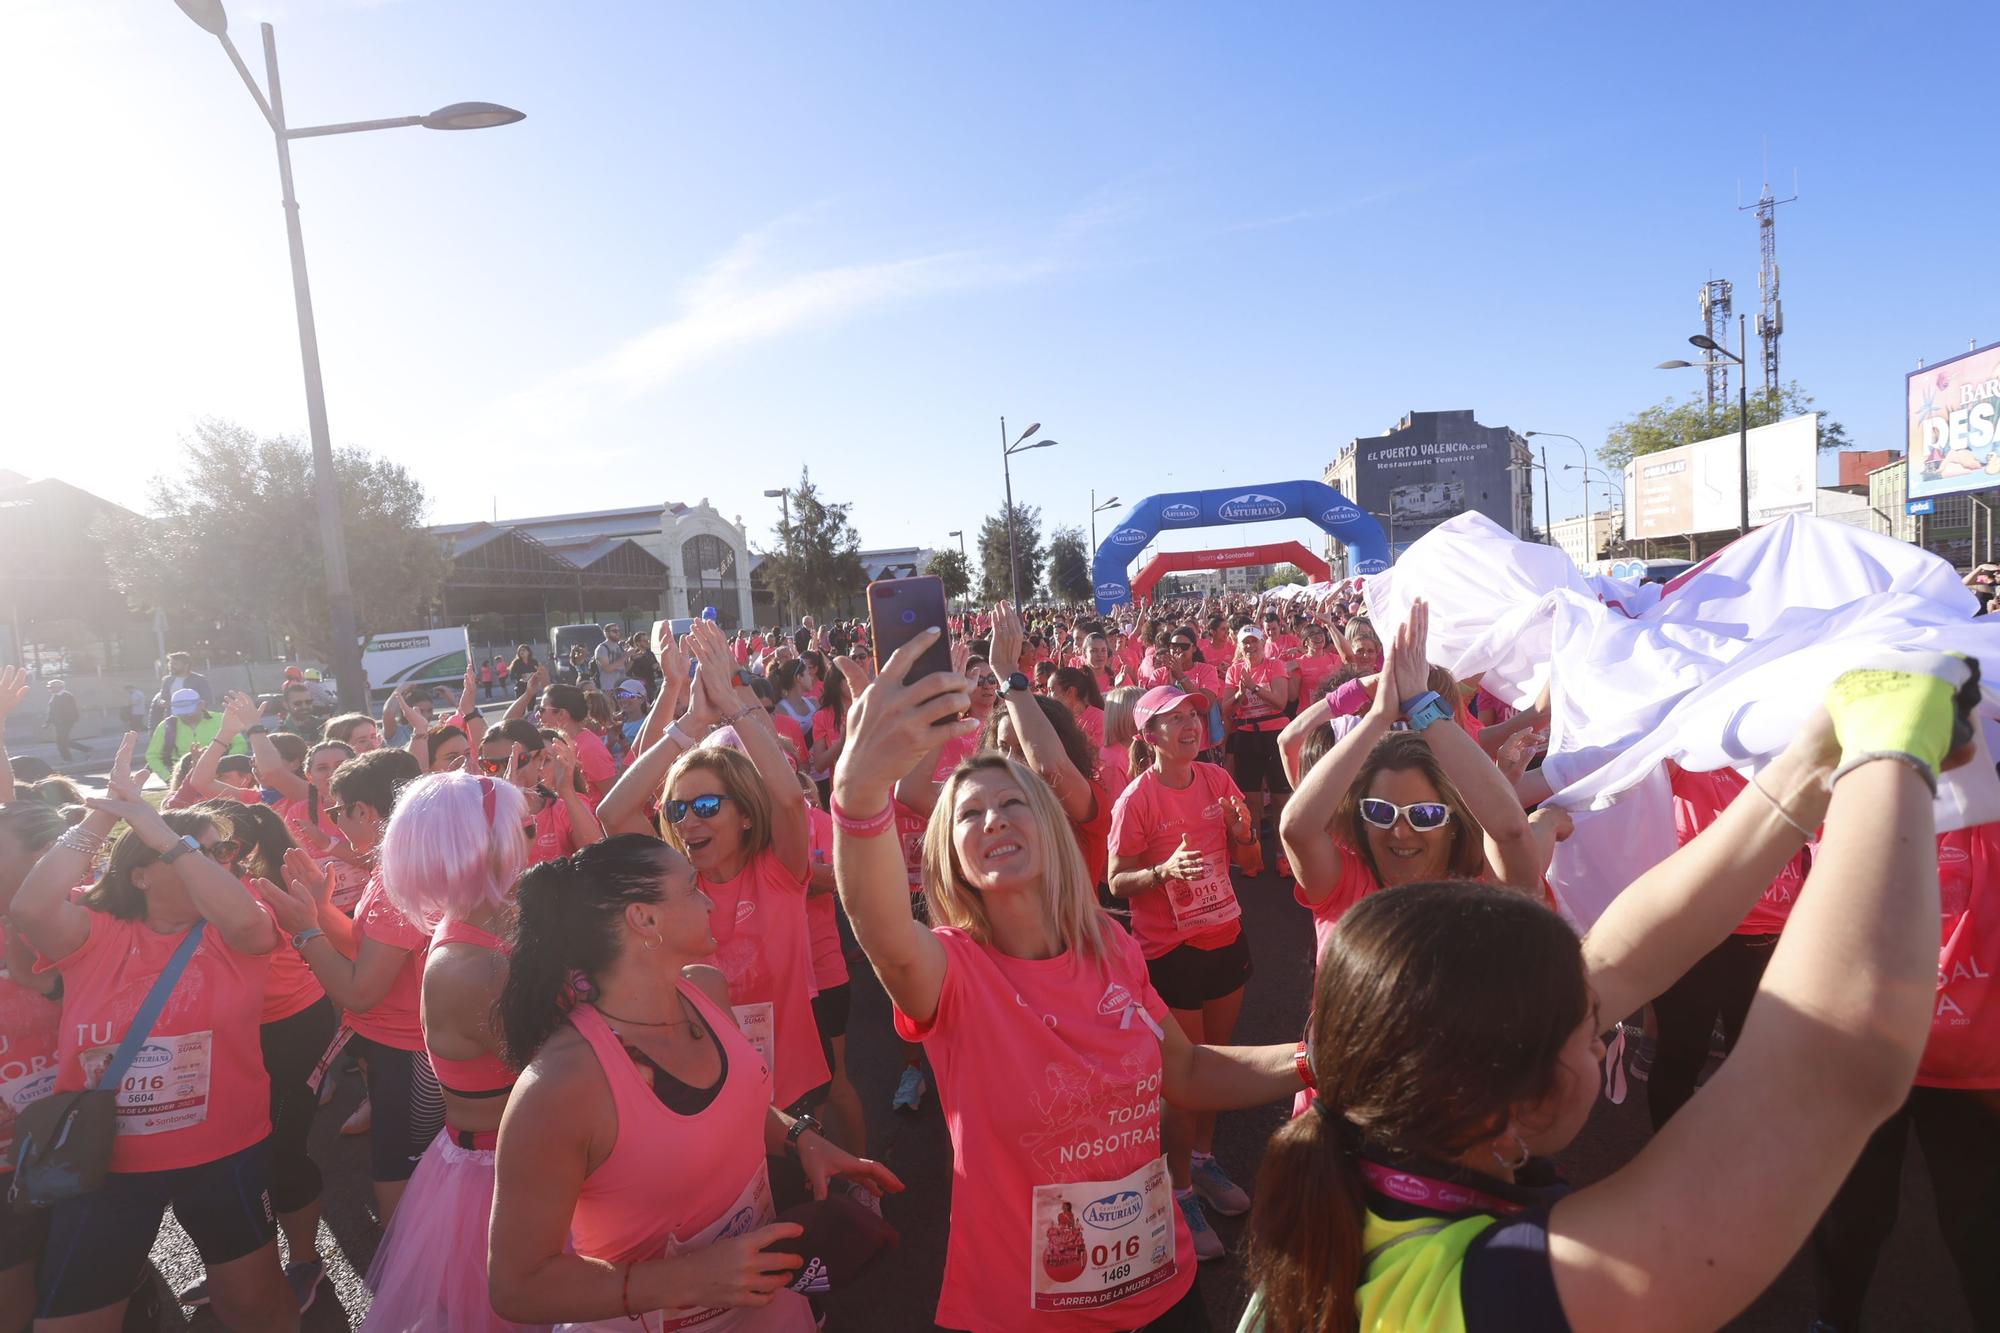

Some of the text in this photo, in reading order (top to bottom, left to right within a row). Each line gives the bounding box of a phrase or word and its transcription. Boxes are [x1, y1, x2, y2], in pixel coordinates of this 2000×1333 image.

[1367, 442, 1488, 461] EL PUERTO VALENCIA.com
[1377, 459, 1432, 470] Restaurante
[1223, 505, 1281, 518] ASTURIANA
[1325, 511, 1358, 521] ASTURIANA
[1224, 551, 1255, 560] Santander
[1097, 589, 1125, 597] ASTURIANA
[1194, 882, 1218, 897] 016
[77, 1021, 113, 1046] TU
[124, 1075, 164, 1091] 016
[128, 1093, 154, 1104] 5604
[155, 1112, 197, 1126] Santander
[1088, 1202, 1142, 1223] ASTURIANA
[1091, 1235, 1140, 1267] 016
[789, 1257, 821, 1291] adida
[1101, 1263, 1131, 1284] 1469
[1053, 1294, 1098, 1307] CARRERA
[1099, 1291, 1112, 1303] DE
[1113, 1289, 1124, 1298] LA
[1125, 1276, 1151, 1293] MUJER
[680, 1307, 724, 1328] CARRERA
